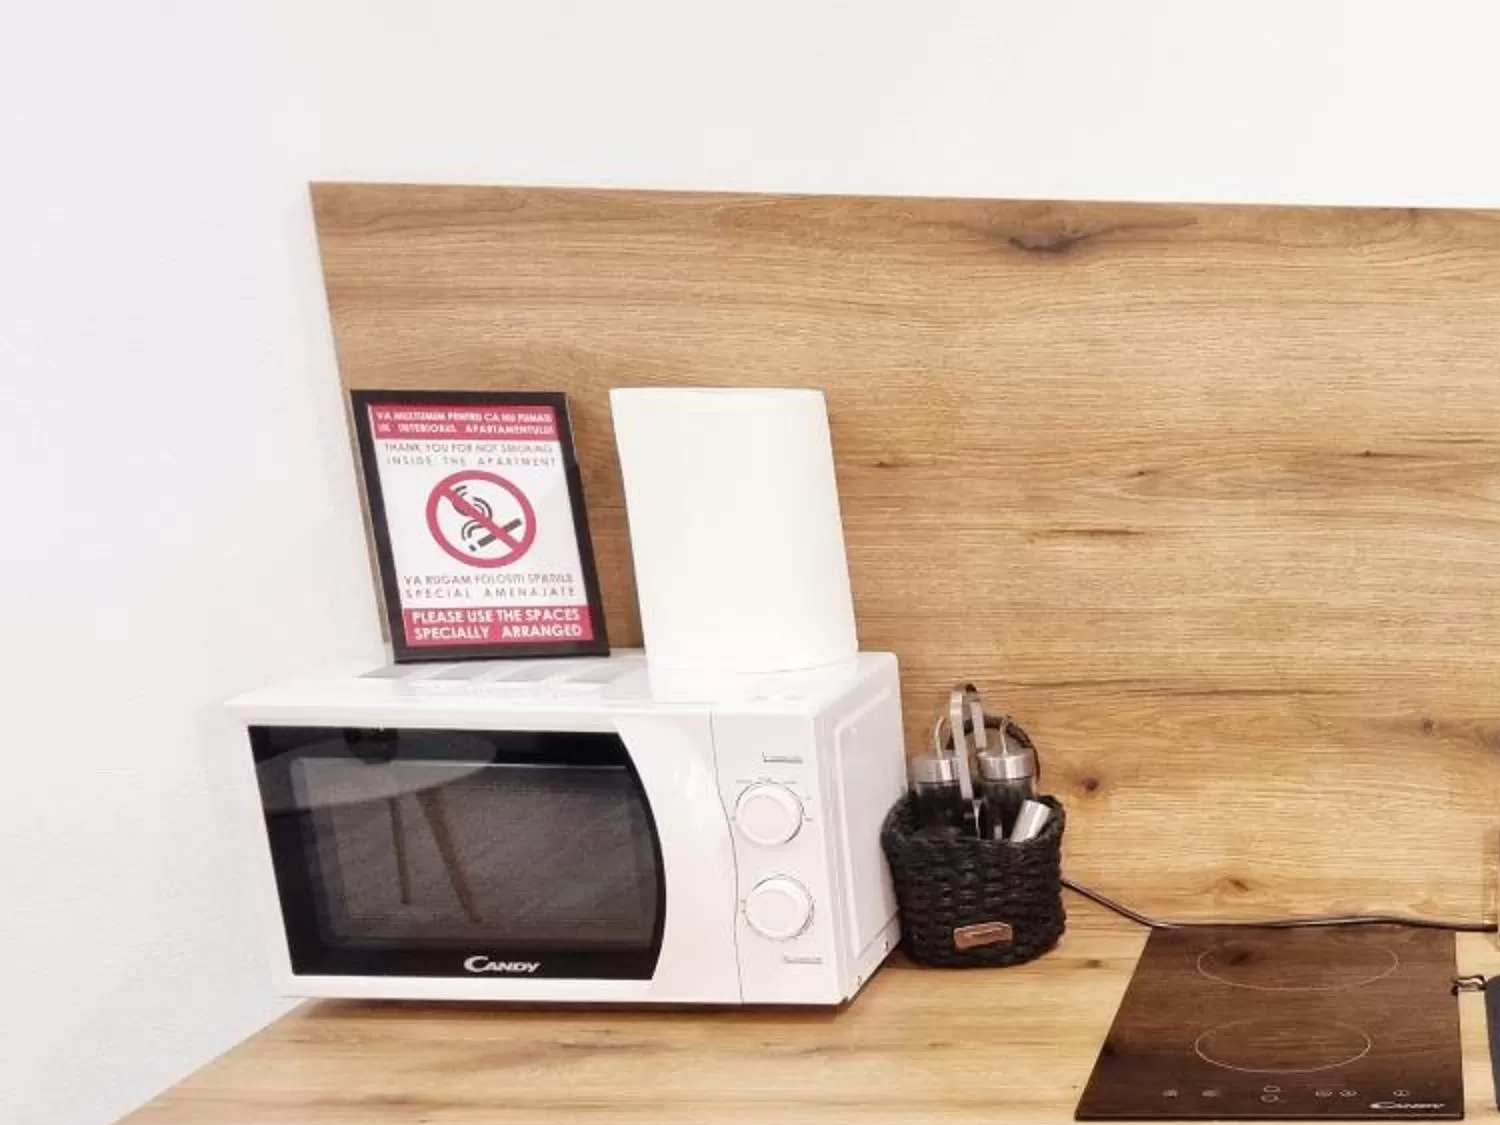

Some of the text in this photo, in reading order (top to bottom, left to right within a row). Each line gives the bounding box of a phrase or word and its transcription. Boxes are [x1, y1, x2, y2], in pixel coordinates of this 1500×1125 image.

[425, 443, 449, 453] YOU
[451, 444, 472, 453] FOR
[403, 575, 421, 585] VA
[405, 587, 470, 599] SPECIAL
[412, 608, 581, 625] PLEASE USE THE SPACES
[414, 624, 583, 641] SPECIALLY ARRANGED
